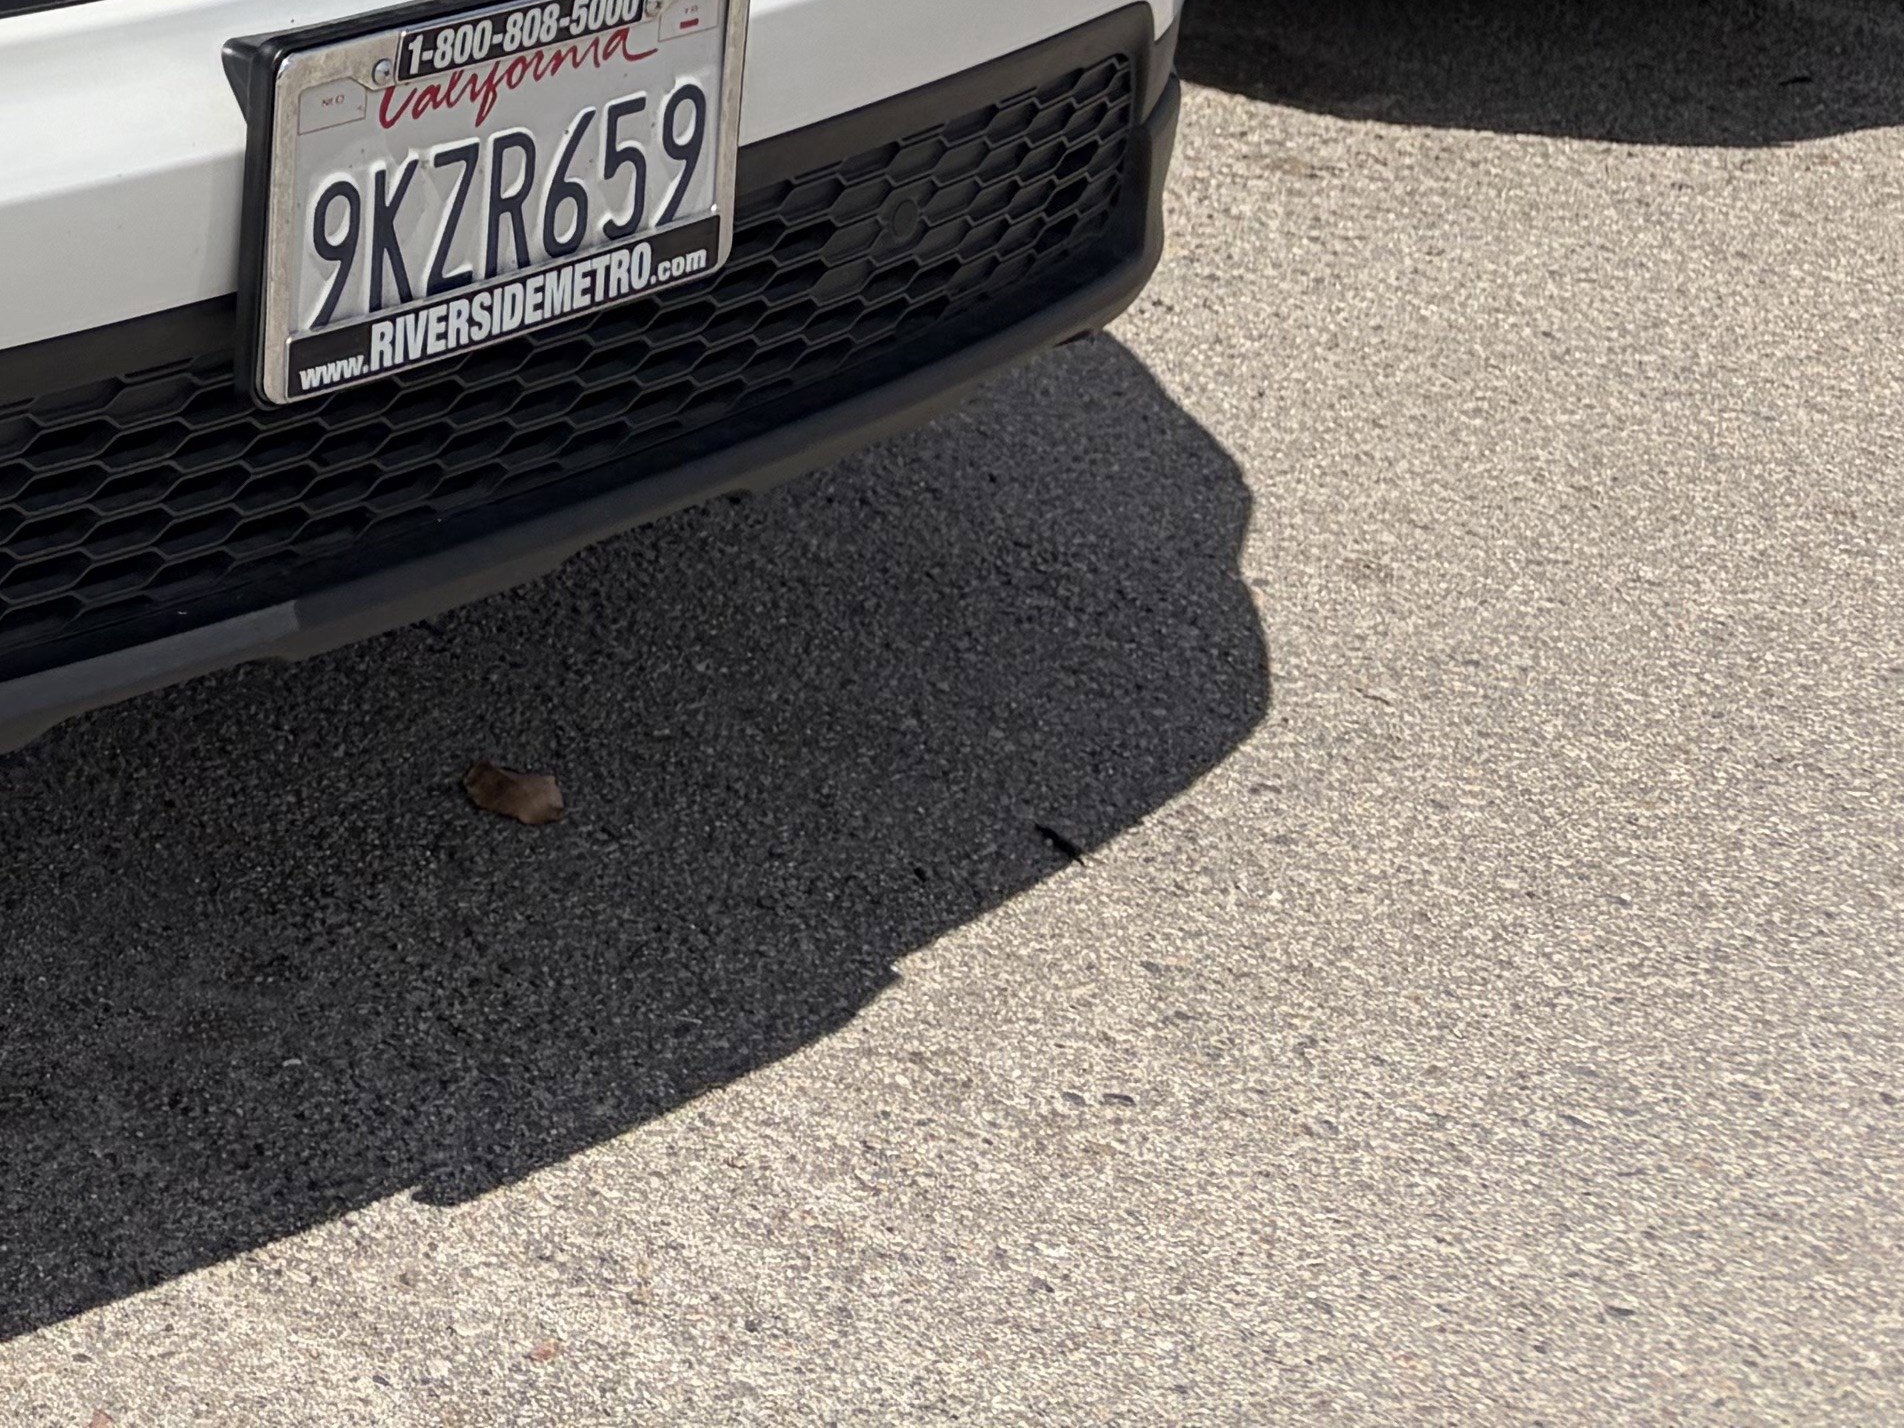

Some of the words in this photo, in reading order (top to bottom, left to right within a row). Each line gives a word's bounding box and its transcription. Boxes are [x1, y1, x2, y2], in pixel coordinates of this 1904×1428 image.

[378, 26, 659, 129] California
[309, 83, 707, 329] 9KZR659
[299, 242, 708, 390] www.RIVERSIDEMETRO.com
